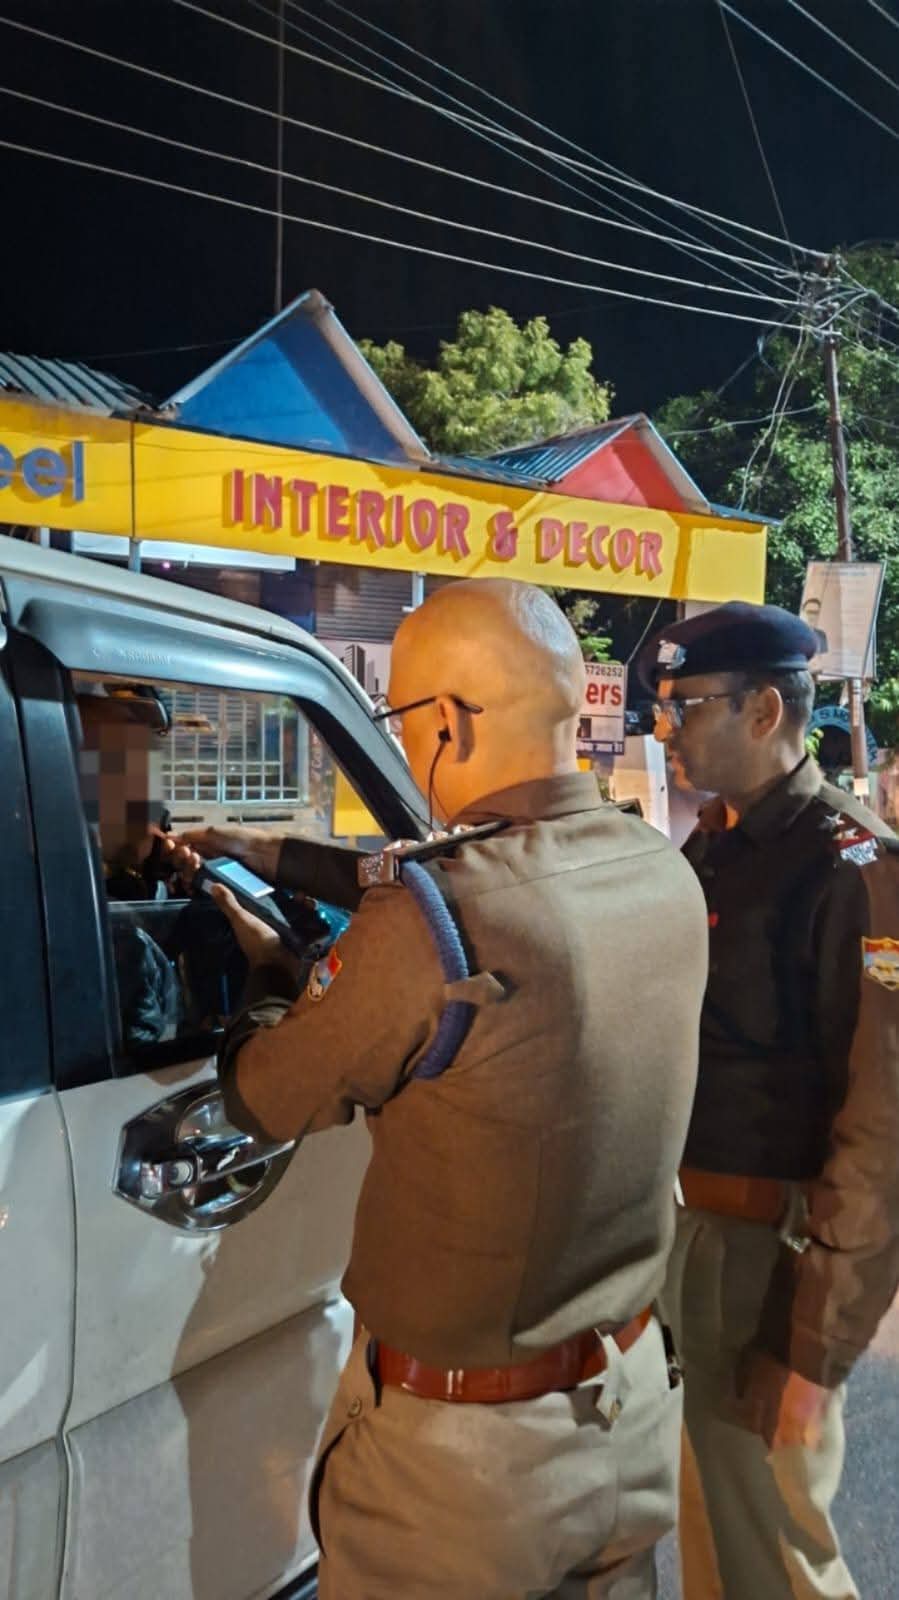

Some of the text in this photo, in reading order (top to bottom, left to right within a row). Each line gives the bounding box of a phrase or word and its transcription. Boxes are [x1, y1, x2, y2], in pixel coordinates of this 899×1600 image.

[230, 468, 663, 577] INTERIOR & DECOR
[585, 682, 622, 706] ers
